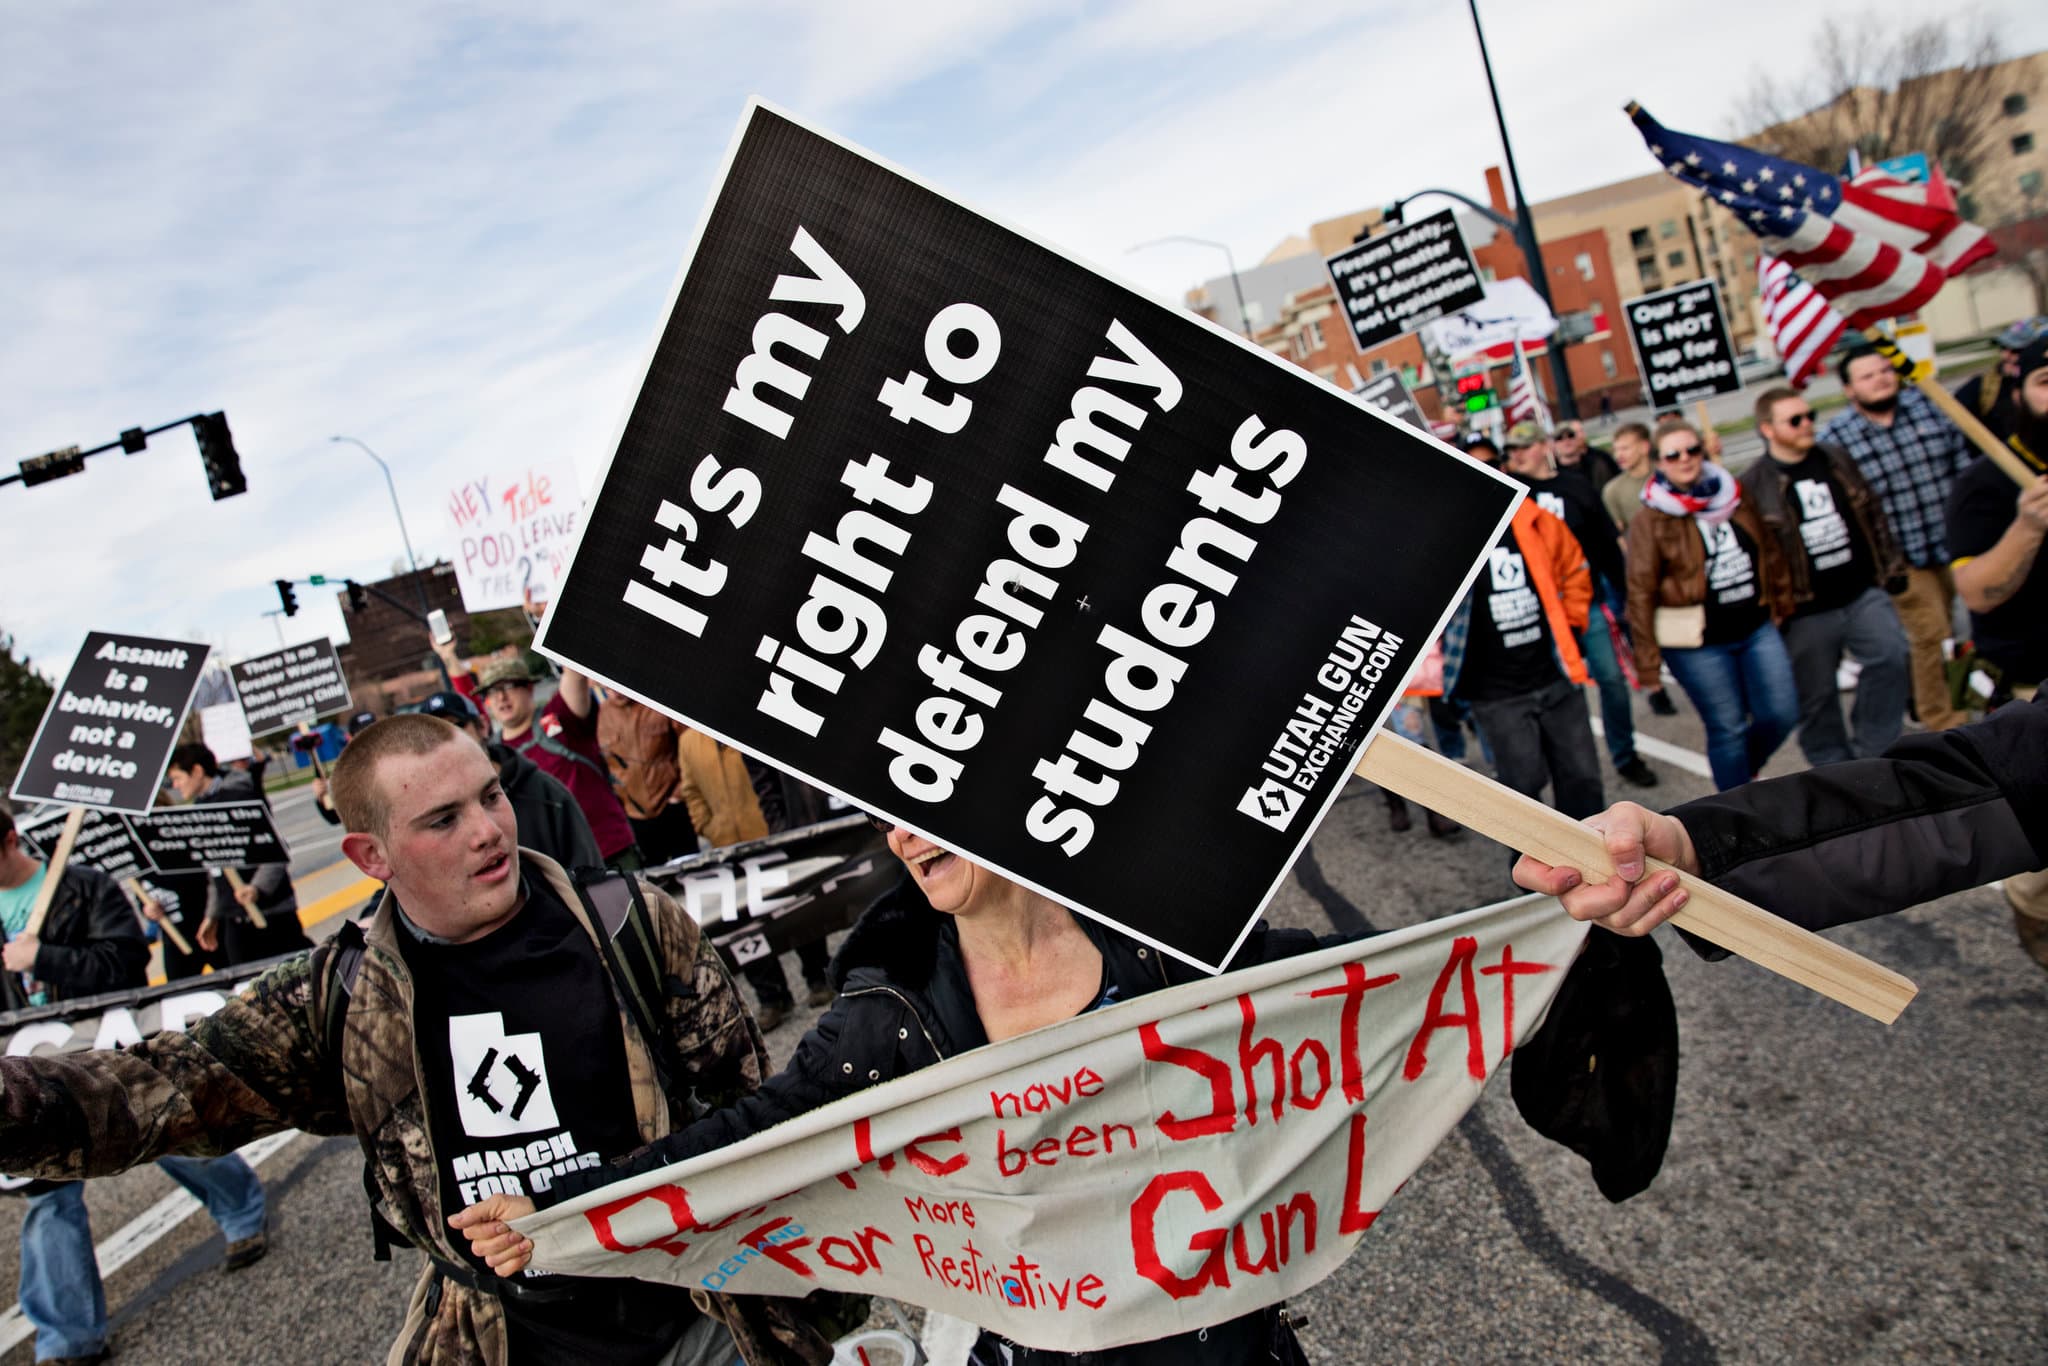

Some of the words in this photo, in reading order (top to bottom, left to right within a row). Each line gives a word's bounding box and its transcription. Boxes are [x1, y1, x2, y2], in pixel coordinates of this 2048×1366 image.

[1379, 265, 1393, 281] a
[1348, 294, 1376, 315] for
[1355, 310, 1385, 334] not
[1633, 301, 1676, 325] Our
[1640, 327, 1663, 347] is
[1663, 311, 1715, 341] NOT
[1650, 347, 1682, 368] up
[1682, 338, 1719, 360] for
[1650, 359, 1732, 391] Debate
[623, 454, 761, 637] It's
[723, 225, 865, 440] my
[450, 475, 493, 528] HEY
[756, 453, 933, 737] right
[877, 303, 1001, 433] to
[461, 530, 516, 577] POD
[520, 511, 576, 549] LEAVE
[878, 484, 1089, 802] defend
[1044, 318, 1182, 492] my
[95, 640, 189, 670] Assault
[1026, 414, 1307, 857] students
[104, 668, 128, 690] is
[130, 674, 148, 692] a
[1262, 693, 1333, 780] UTAH
[1317, 614, 1382, 692] GUN
[58, 690, 175, 729] behavior,
[1293, 631, 1404, 792] EXCHANGE.COM
[69, 724, 116, 746] not
[117, 731, 136, 749] a
[52, 749, 138, 780] device
[452, 1131, 578, 1182] MARCH
[998, 1123, 1137, 1177] been
[459, 1174, 526, 1206] FOR
[701, 1222, 806, 1293] DEMAND
[738, 1216, 896, 1281] For
[1131, 1170, 1317, 1300] Gun
[914, 1233, 1108, 1311] Restrictive
